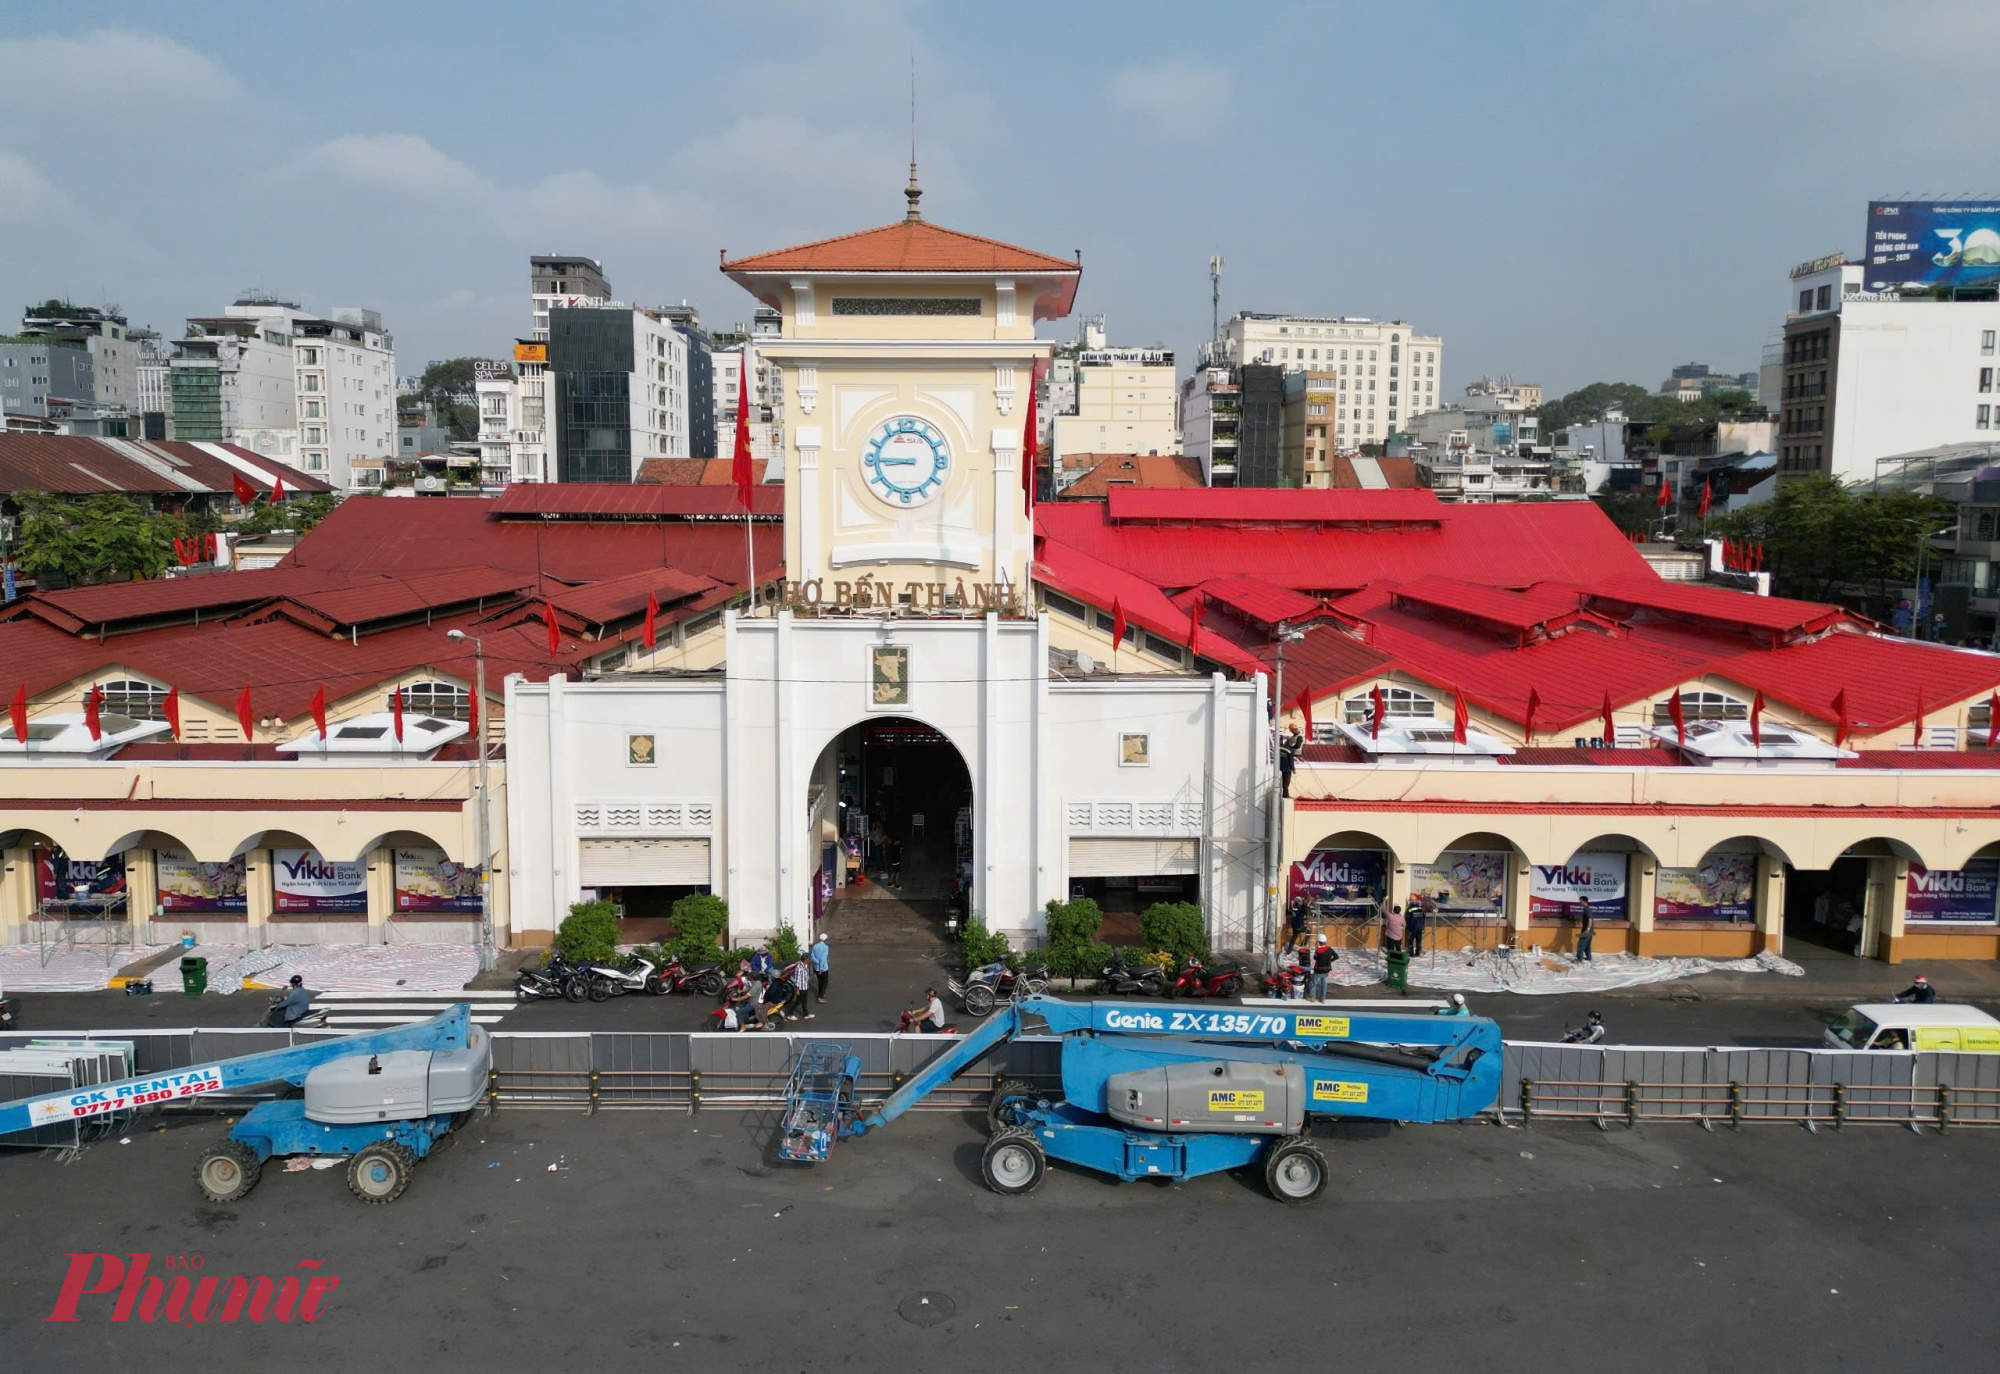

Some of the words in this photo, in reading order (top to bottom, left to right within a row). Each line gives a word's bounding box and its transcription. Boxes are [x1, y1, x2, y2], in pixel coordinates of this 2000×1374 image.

[1888, 232, 1907, 240] PHONG
[1879, 292, 1900, 301] BAR
[474, 361, 508, 371] CELEB
[475, 370, 494, 380] SPA
[864, 452, 876, 467] 9
[900, 490, 912, 503] 6
[759, 577, 824, 608] CHỢ
[833, 572, 894, 608] BẾN
[904, 576, 1016, 609] THÀNH
[281, 851, 335, 880] Vikki
[1295, 852, 1349, 882] Vikki
[337, 871, 362, 880] Bank
[1538, 865, 1592, 885] Vikki
[1909, 870, 1965, 892] Vikki
[1594, 877, 1618, 886] Bank
[1966, 883, 1991, 892] Bank
[1105, 1010, 1164, 1030] Genie
[1298, 1018, 1322, 1028] AMC
[70, 1091, 108, 1107] GK
[116, 1070, 218, 1098] RENTAL
[1316, 1082, 1340, 1093] AMC
[72, 1098, 125, 1117] 0777
[133, 1089, 173, 1105] 880
[180, 1080, 220, 1096] 222
[1211, 1092, 1236, 1103] AMC
